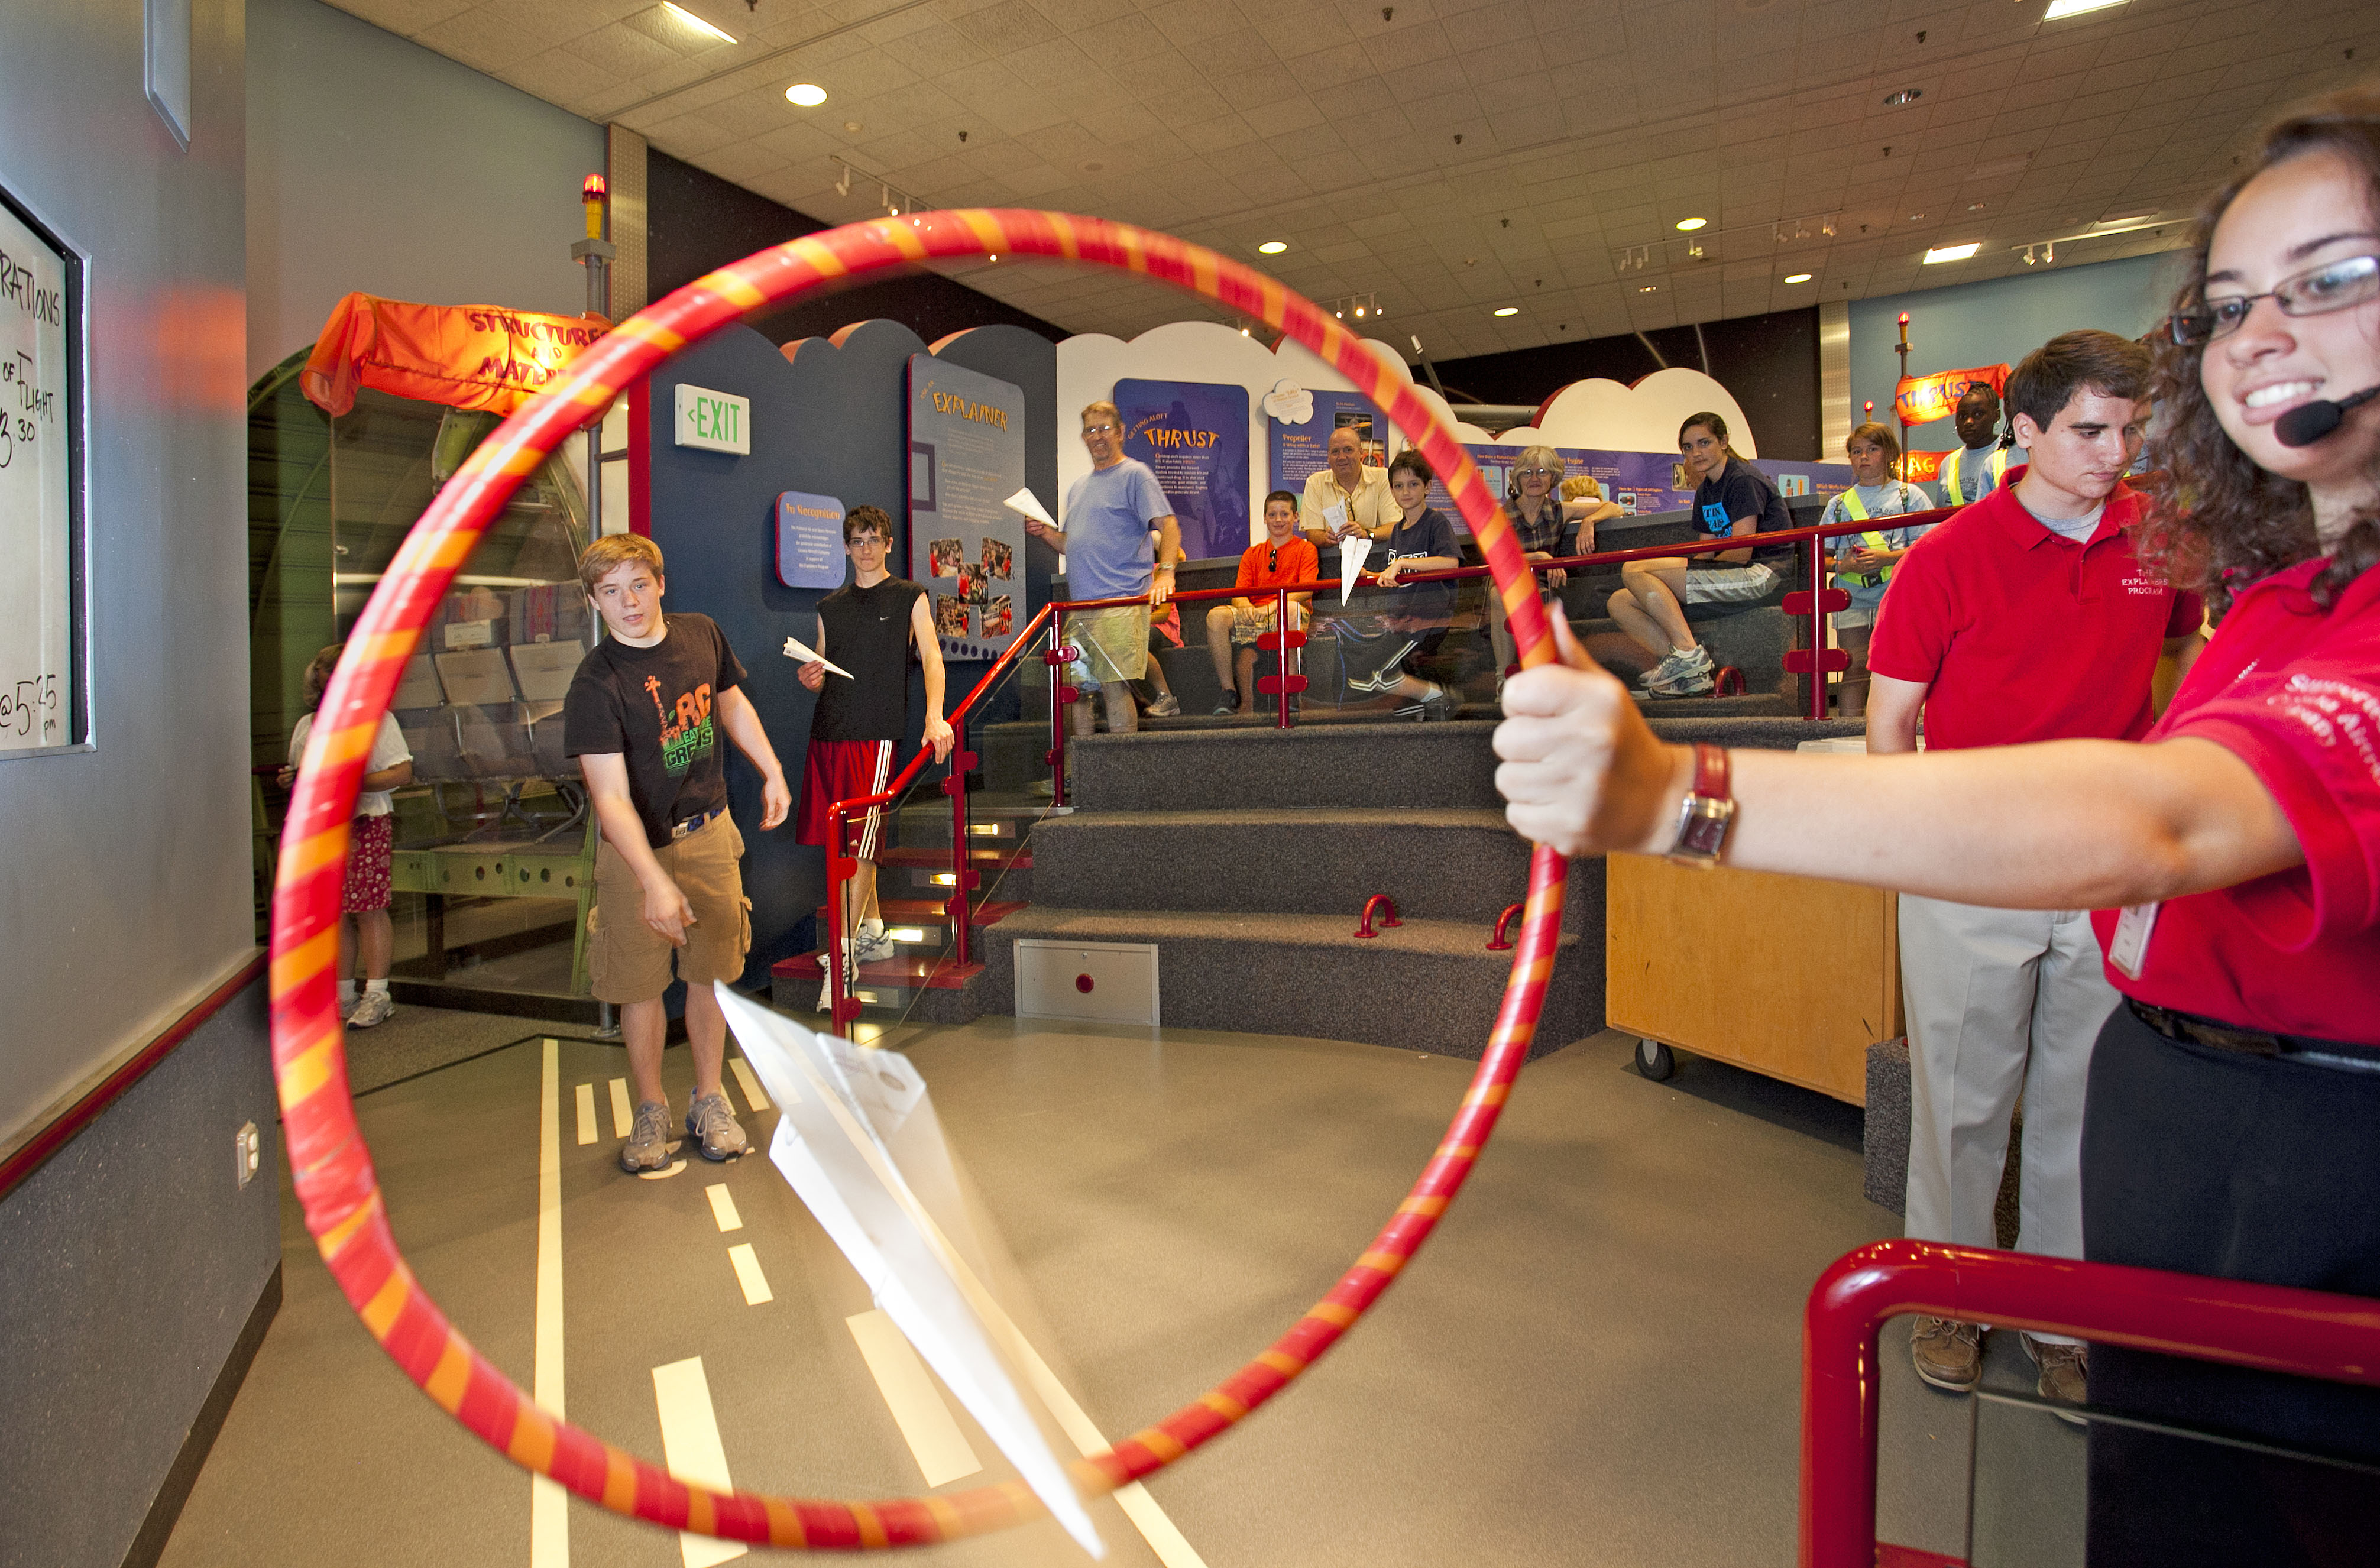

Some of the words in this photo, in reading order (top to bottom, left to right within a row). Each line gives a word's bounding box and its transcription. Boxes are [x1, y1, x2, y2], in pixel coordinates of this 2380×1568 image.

[3, 362, 15, 382] OF
[17, 349, 53, 423] FLIGHT
[697, 396, 740, 443] EXIT
[932, 391, 1009, 432] EXPLAINER
[1128, 418, 1149, 440] GETTING
[1149, 413, 1167, 422] ALOFT
[1143, 427, 1220, 449] THRUST
[1282, 433, 1312, 443] Propeller
[1907, 456, 1935, 475] AG
[785, 503, 795, 514] In
[796, 504, 840, 520] Recognition
[682, 727, 698, 743] EAT
